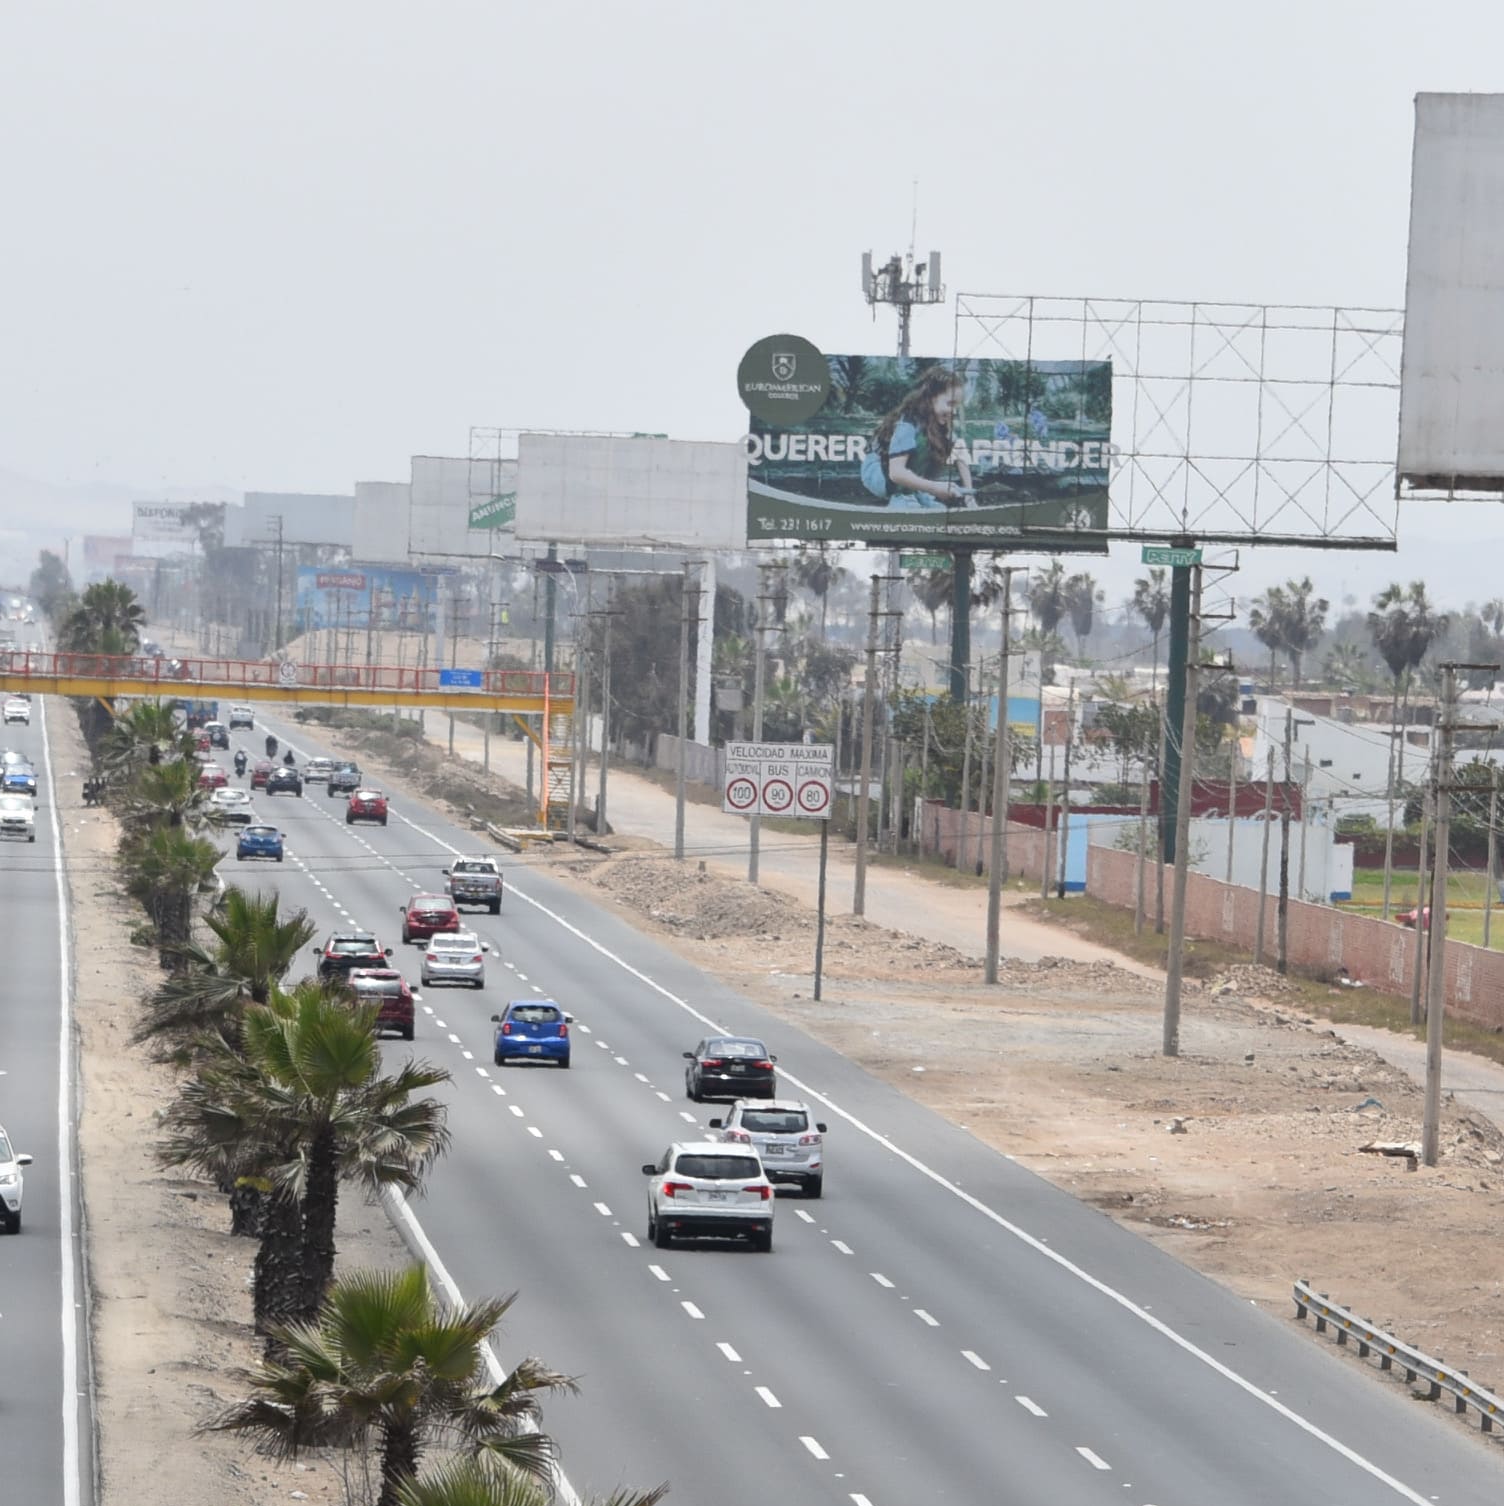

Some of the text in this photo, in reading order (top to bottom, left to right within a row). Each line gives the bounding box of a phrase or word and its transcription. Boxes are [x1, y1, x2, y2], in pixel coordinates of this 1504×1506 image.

[738, 433, 867, 466] QUERER
[806, 519, 833, 531] 1617
[730, 746, 785, 759] VELOCIDAD
[768, 765, 789, 776] BUS
[733, 786, 751, 800] 100
[771, 789, 785, 801] 90
[806, 790, 820, 803] 80
